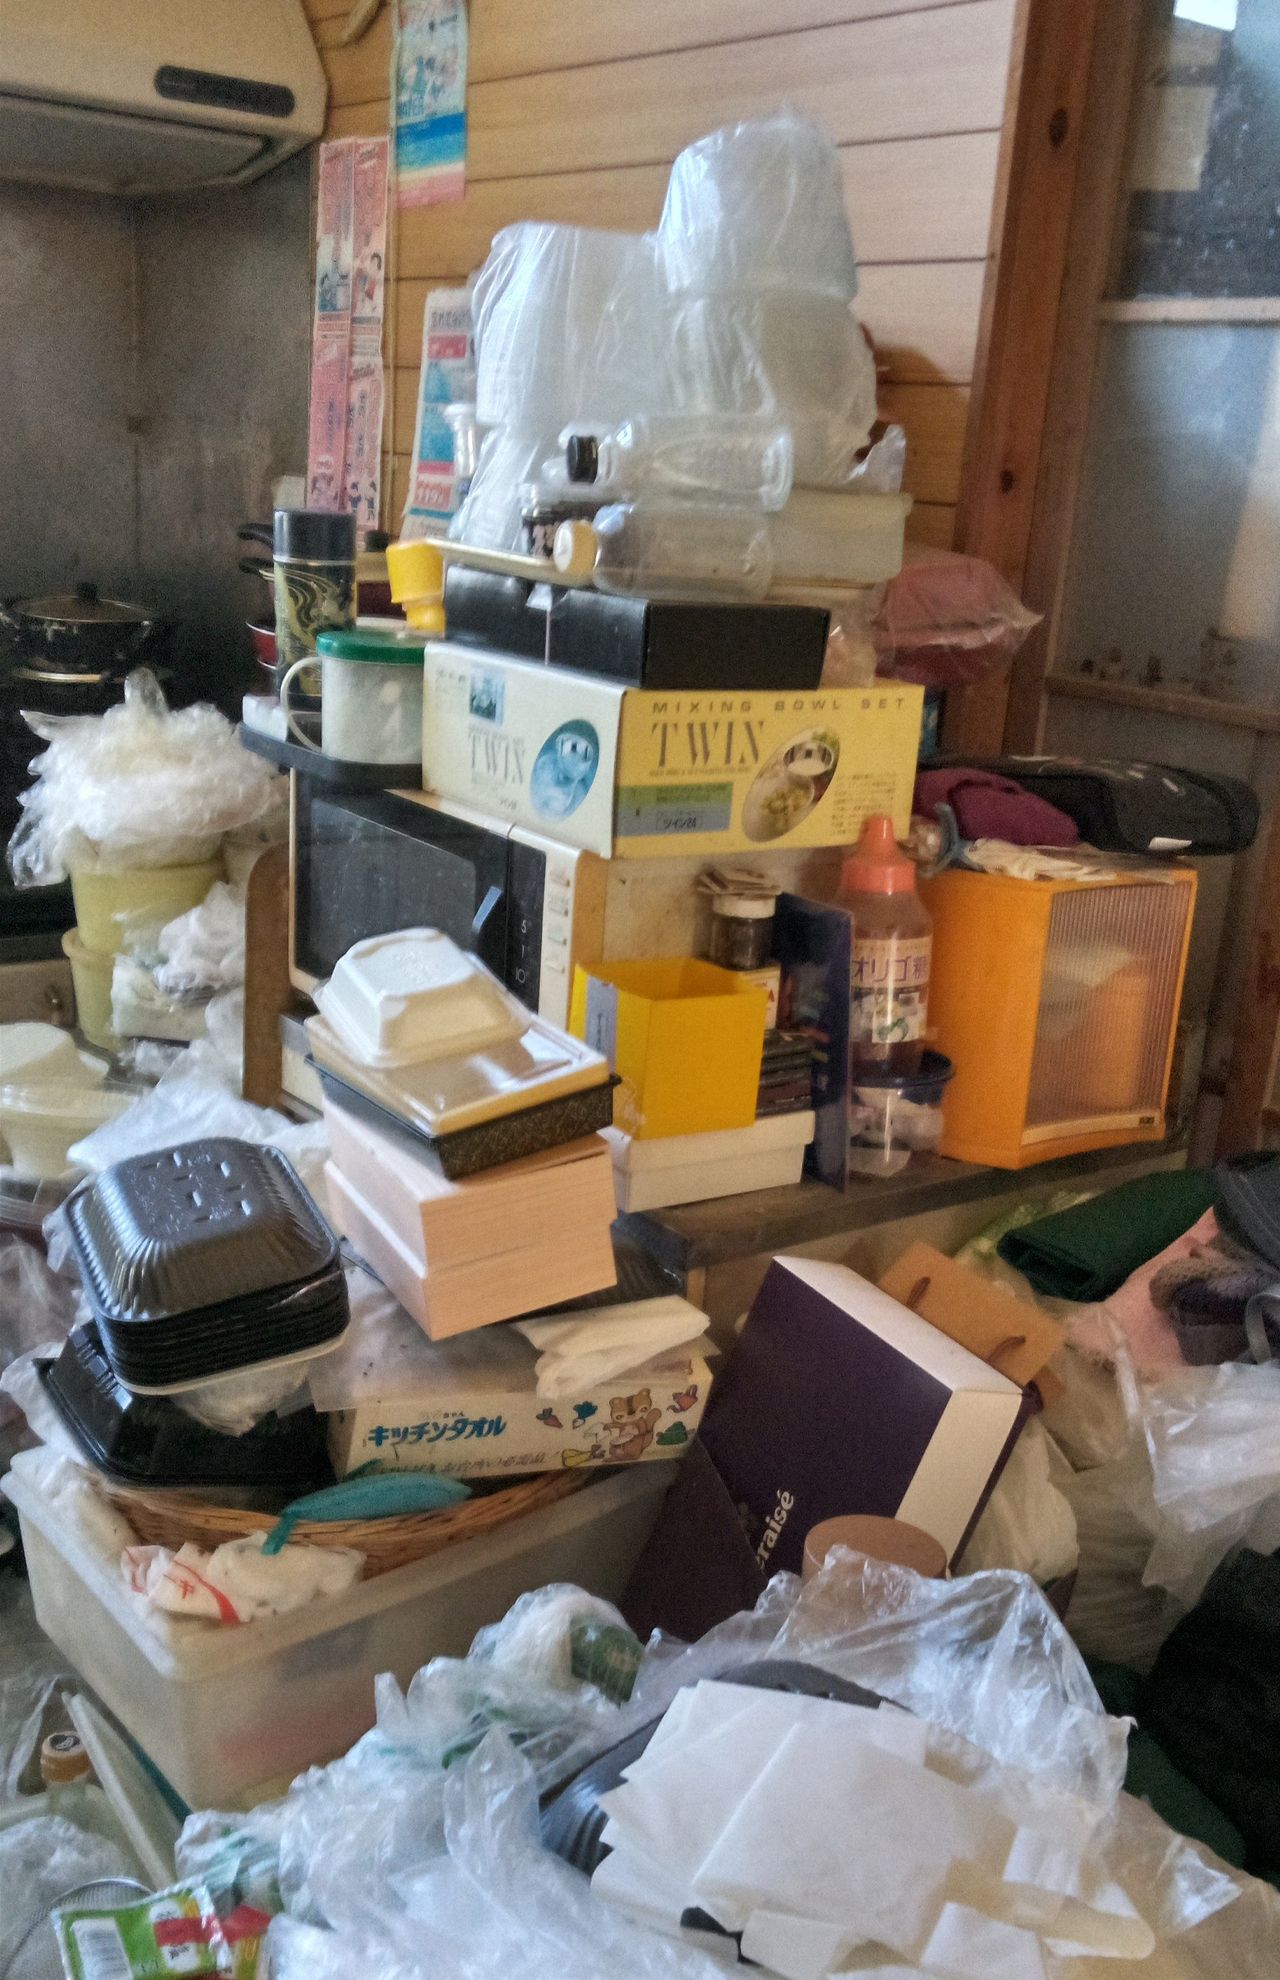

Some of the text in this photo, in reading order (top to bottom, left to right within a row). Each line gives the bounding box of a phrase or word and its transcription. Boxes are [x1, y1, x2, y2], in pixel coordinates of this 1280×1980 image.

[652, 697, 905, 713] MIXING BOWL SET
[368, 1415, 507, 1447] キッチンタオル
[755, 1489, 794, 1571] raisé
